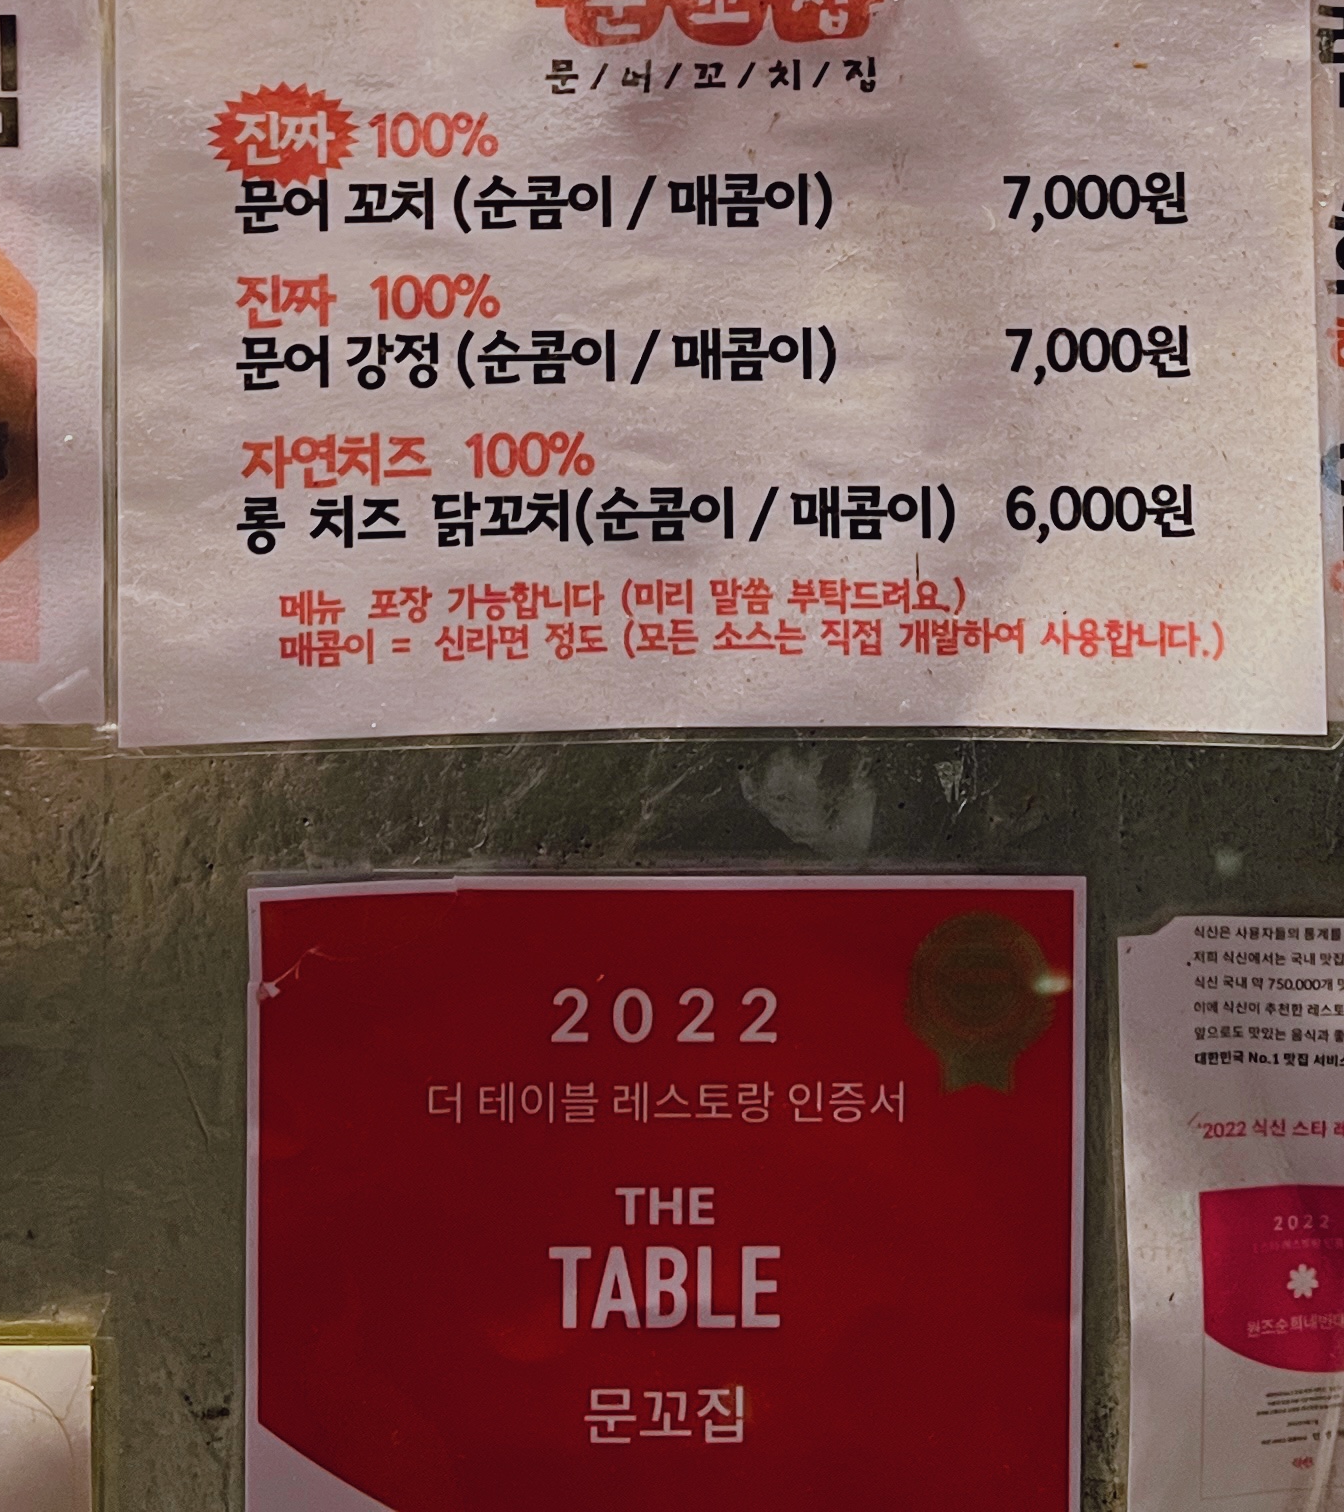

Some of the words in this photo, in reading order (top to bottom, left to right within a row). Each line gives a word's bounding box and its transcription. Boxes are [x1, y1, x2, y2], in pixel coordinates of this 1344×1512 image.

[234, 110, 336, 166] 진짜
[368, 111, 500, 159] 100%
[234, 178, 329, 235] 문어
[344, 177, 434, 231] 꼬치
[453, 174, 612, 234] (순콤이
[667, 170, 833, 230] 매콤이)
[1003, 171, 1189, 233] 7,000원
[236, 273, 337, 330] 진짜
[370, 273, 501, 321] 100%
[235, 334, 330, 392] 문어
[346, 331, 439, 391] 강정
[457, 329, 616, 390] (순콤이
[671, 324, 837, 385] 매콤이)
[1005, 324, 1191, 386] 7,000원
[241, 431, 433, 490] 자연치즈
[465, 430, 596, 479] 100%
[236, 496, 286, 555] 롱
[309, 494, 407, 549] 치즈
[789, 483, 956, 544] 매콤이)
[1005, 483, 1196, 544] 6,000원
[279, 589, 345, 627] 메뉴
[367, 584, 433, 625] 포장
[448, 580, 606, 623] 가능합니다
[620, 578, 694, 617] (미리
[709, 577, 774, 617] 말씀
[279, 627, 375, 669] 매콤이
[434, 623, 529, 663] 신라면
[545, 621, 609, 662] 정도
[623, 617, 699, 660] (모든
[712, 618, 807, 657] 소스는
[821, 618, 883, 657] 직접
[899, 617, 1025, 657] 개발하여
[1040, 617, 1225, 661] 사용합니다.)
[551, 987, 778, 1044] 2022
[428, 1081, 462, 1124] 더
[479, 1081, 599, 1124] 테이블
[613, 1080, 775, 1124] 레스토랑
[788, 1080, 905, 1123] 인증서
[615, 1187, 715, 1226] THE
[548, 1245, 781, 1329] TABLE
[584, 1385, 744, 1444] 문꼬집
